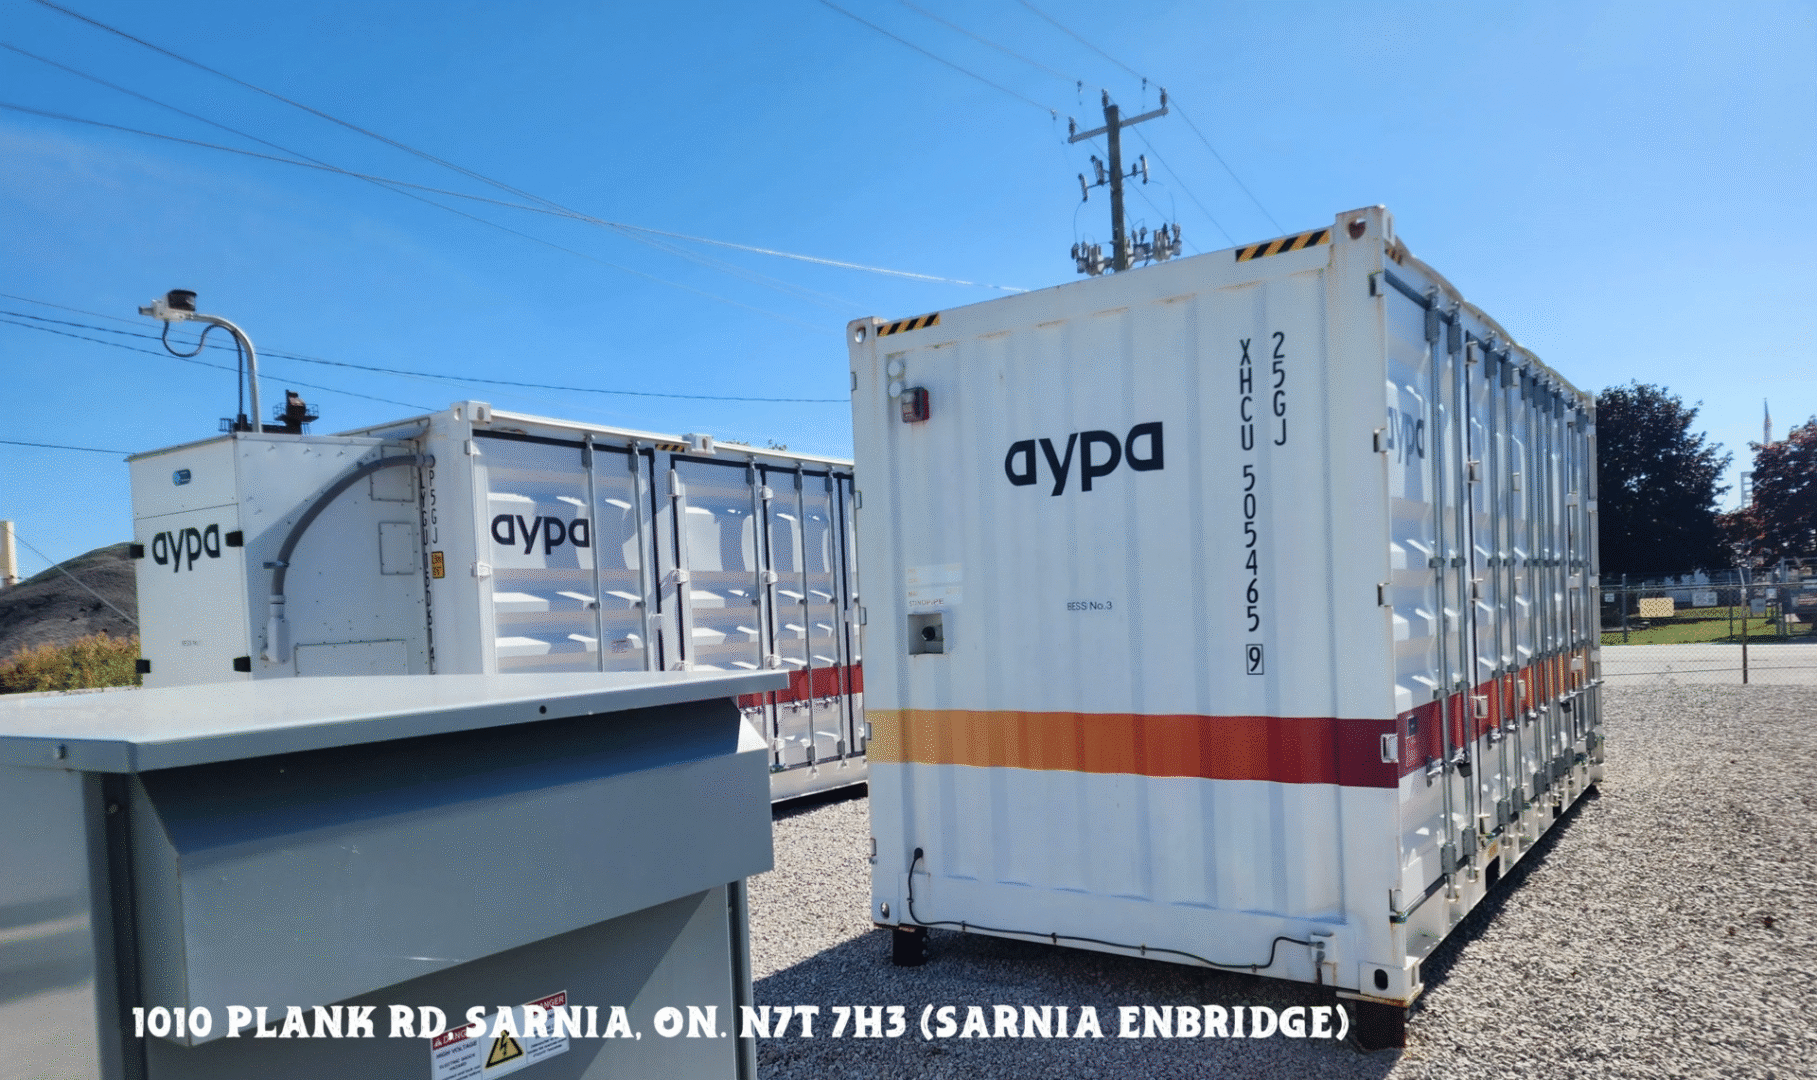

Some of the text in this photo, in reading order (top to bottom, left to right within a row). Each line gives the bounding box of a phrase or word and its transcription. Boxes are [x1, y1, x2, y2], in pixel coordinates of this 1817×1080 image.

[1272, 331, 1287, 446] 25GJ
[1005, 421, 1164, 497] aypa
[491, 514, 590, 555] aypa
[1239, 338, 1261, 672] XHCU 505465 9
[152, 524, 221, 573] aypa
